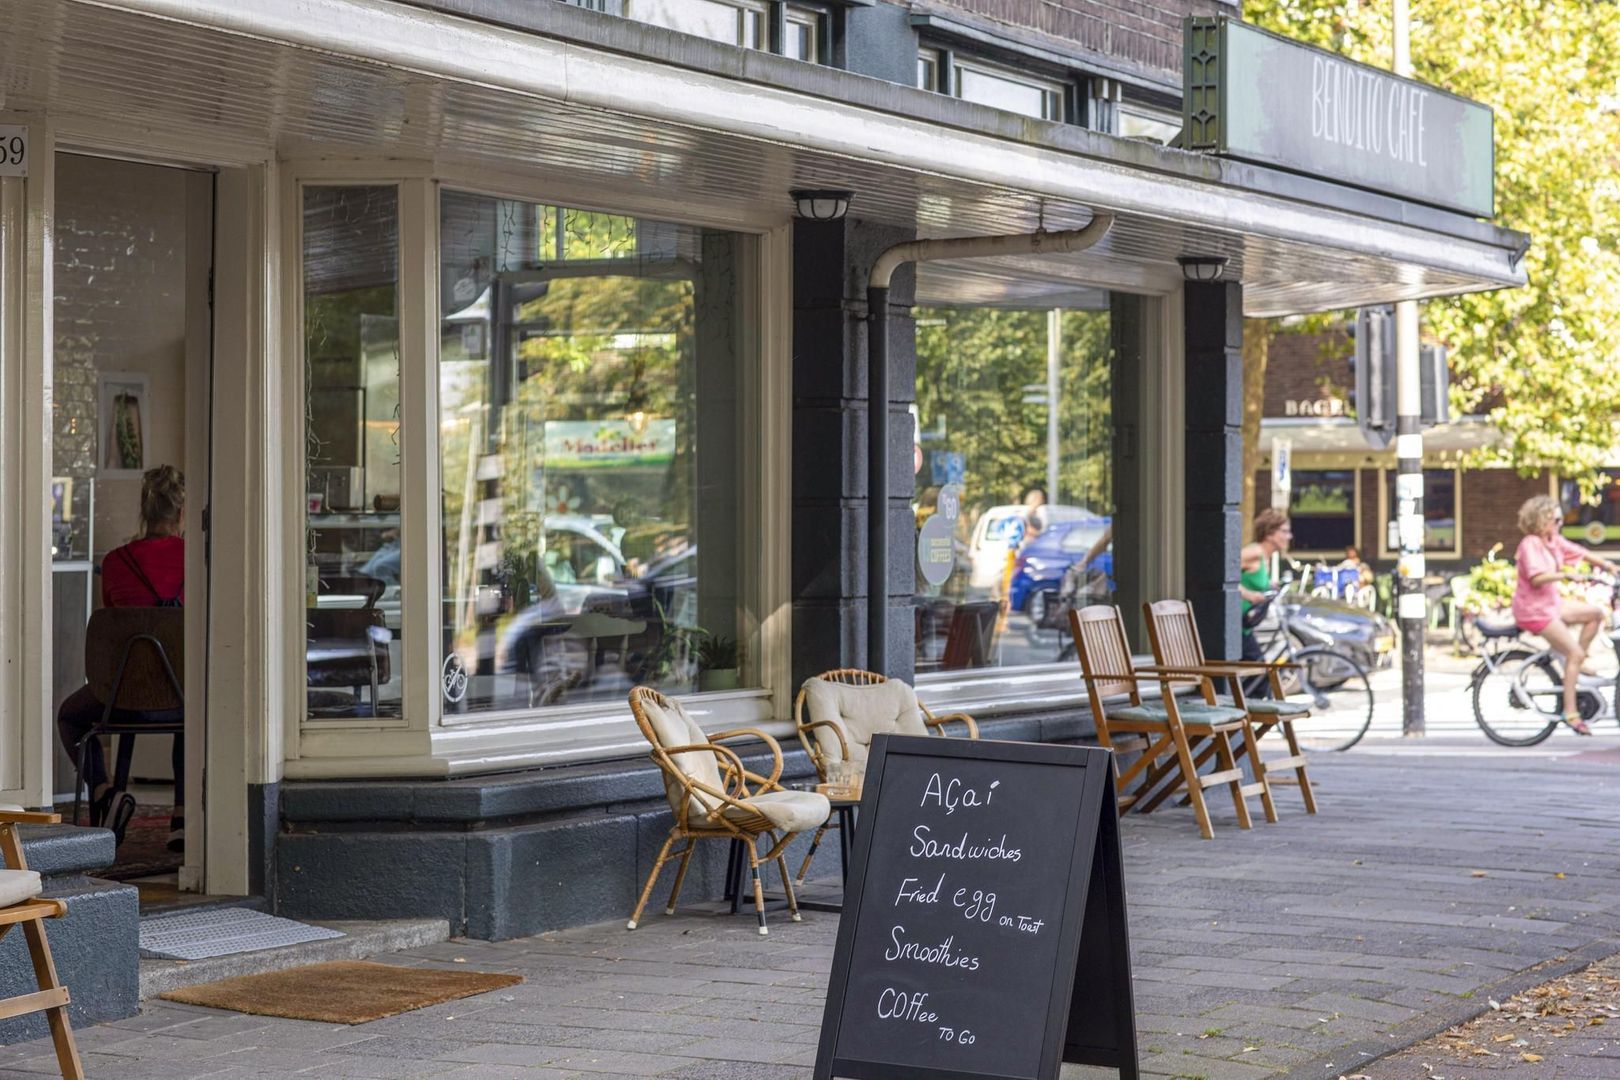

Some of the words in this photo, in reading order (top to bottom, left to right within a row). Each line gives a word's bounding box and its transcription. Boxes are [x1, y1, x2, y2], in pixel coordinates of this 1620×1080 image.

[1311, 55, 1384, 154] BENDITO
[1387, 80, 1429, 168] CAFE
[909, 824, 1022, 863] Sandwiches
[894, 872, 946, 907] Fried
[953, 887, 997, 923] egg
[998, 914, 1014, 928] on
[885, 925, 980, 971] Smoothies
